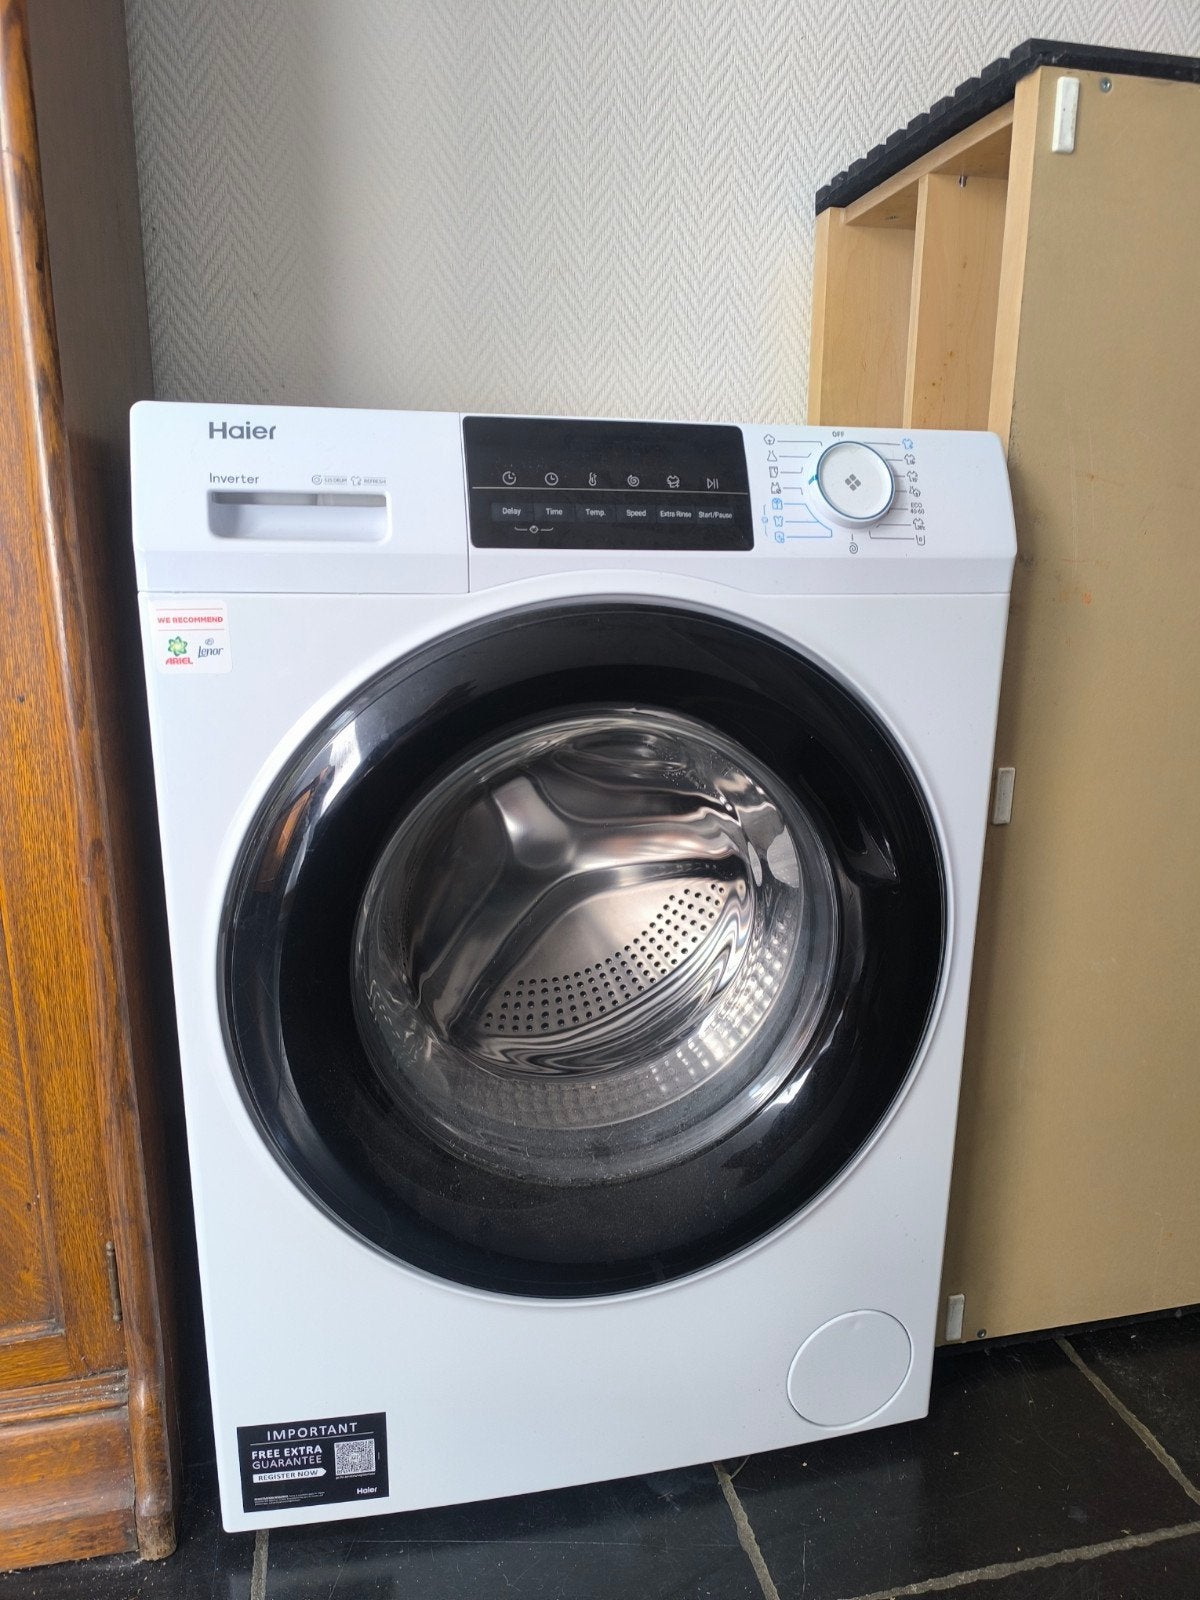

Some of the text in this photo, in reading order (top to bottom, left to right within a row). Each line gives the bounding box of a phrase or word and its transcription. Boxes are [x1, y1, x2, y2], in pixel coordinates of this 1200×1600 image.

[208, 421, 276, 440] Haier
[209, 472, 259, 484] Inverter
[502, 507, 521, 516] Delay
[585, 508, 606, 517] Temp.
[626, 509, 647, 518] Speed
[676, 510, 692, 518] Rinse
[698, 511, 733, 519] Start/Pause
[172, 616, 224, 624] RECOMMEND
[197, 645, 224, 658] Lenor
[165, 657, 194, 665] ARIEL
[267, 1422, 358, 1441] IMPORTANT
[251, 1444, 323, 1460] FREE EXTRA
[252, 1455, 323, 1470] GUARANTEE
[258, 1469, 318, 1482] REGISTER NOW
[356, 1486, 378, 1495] Haier
